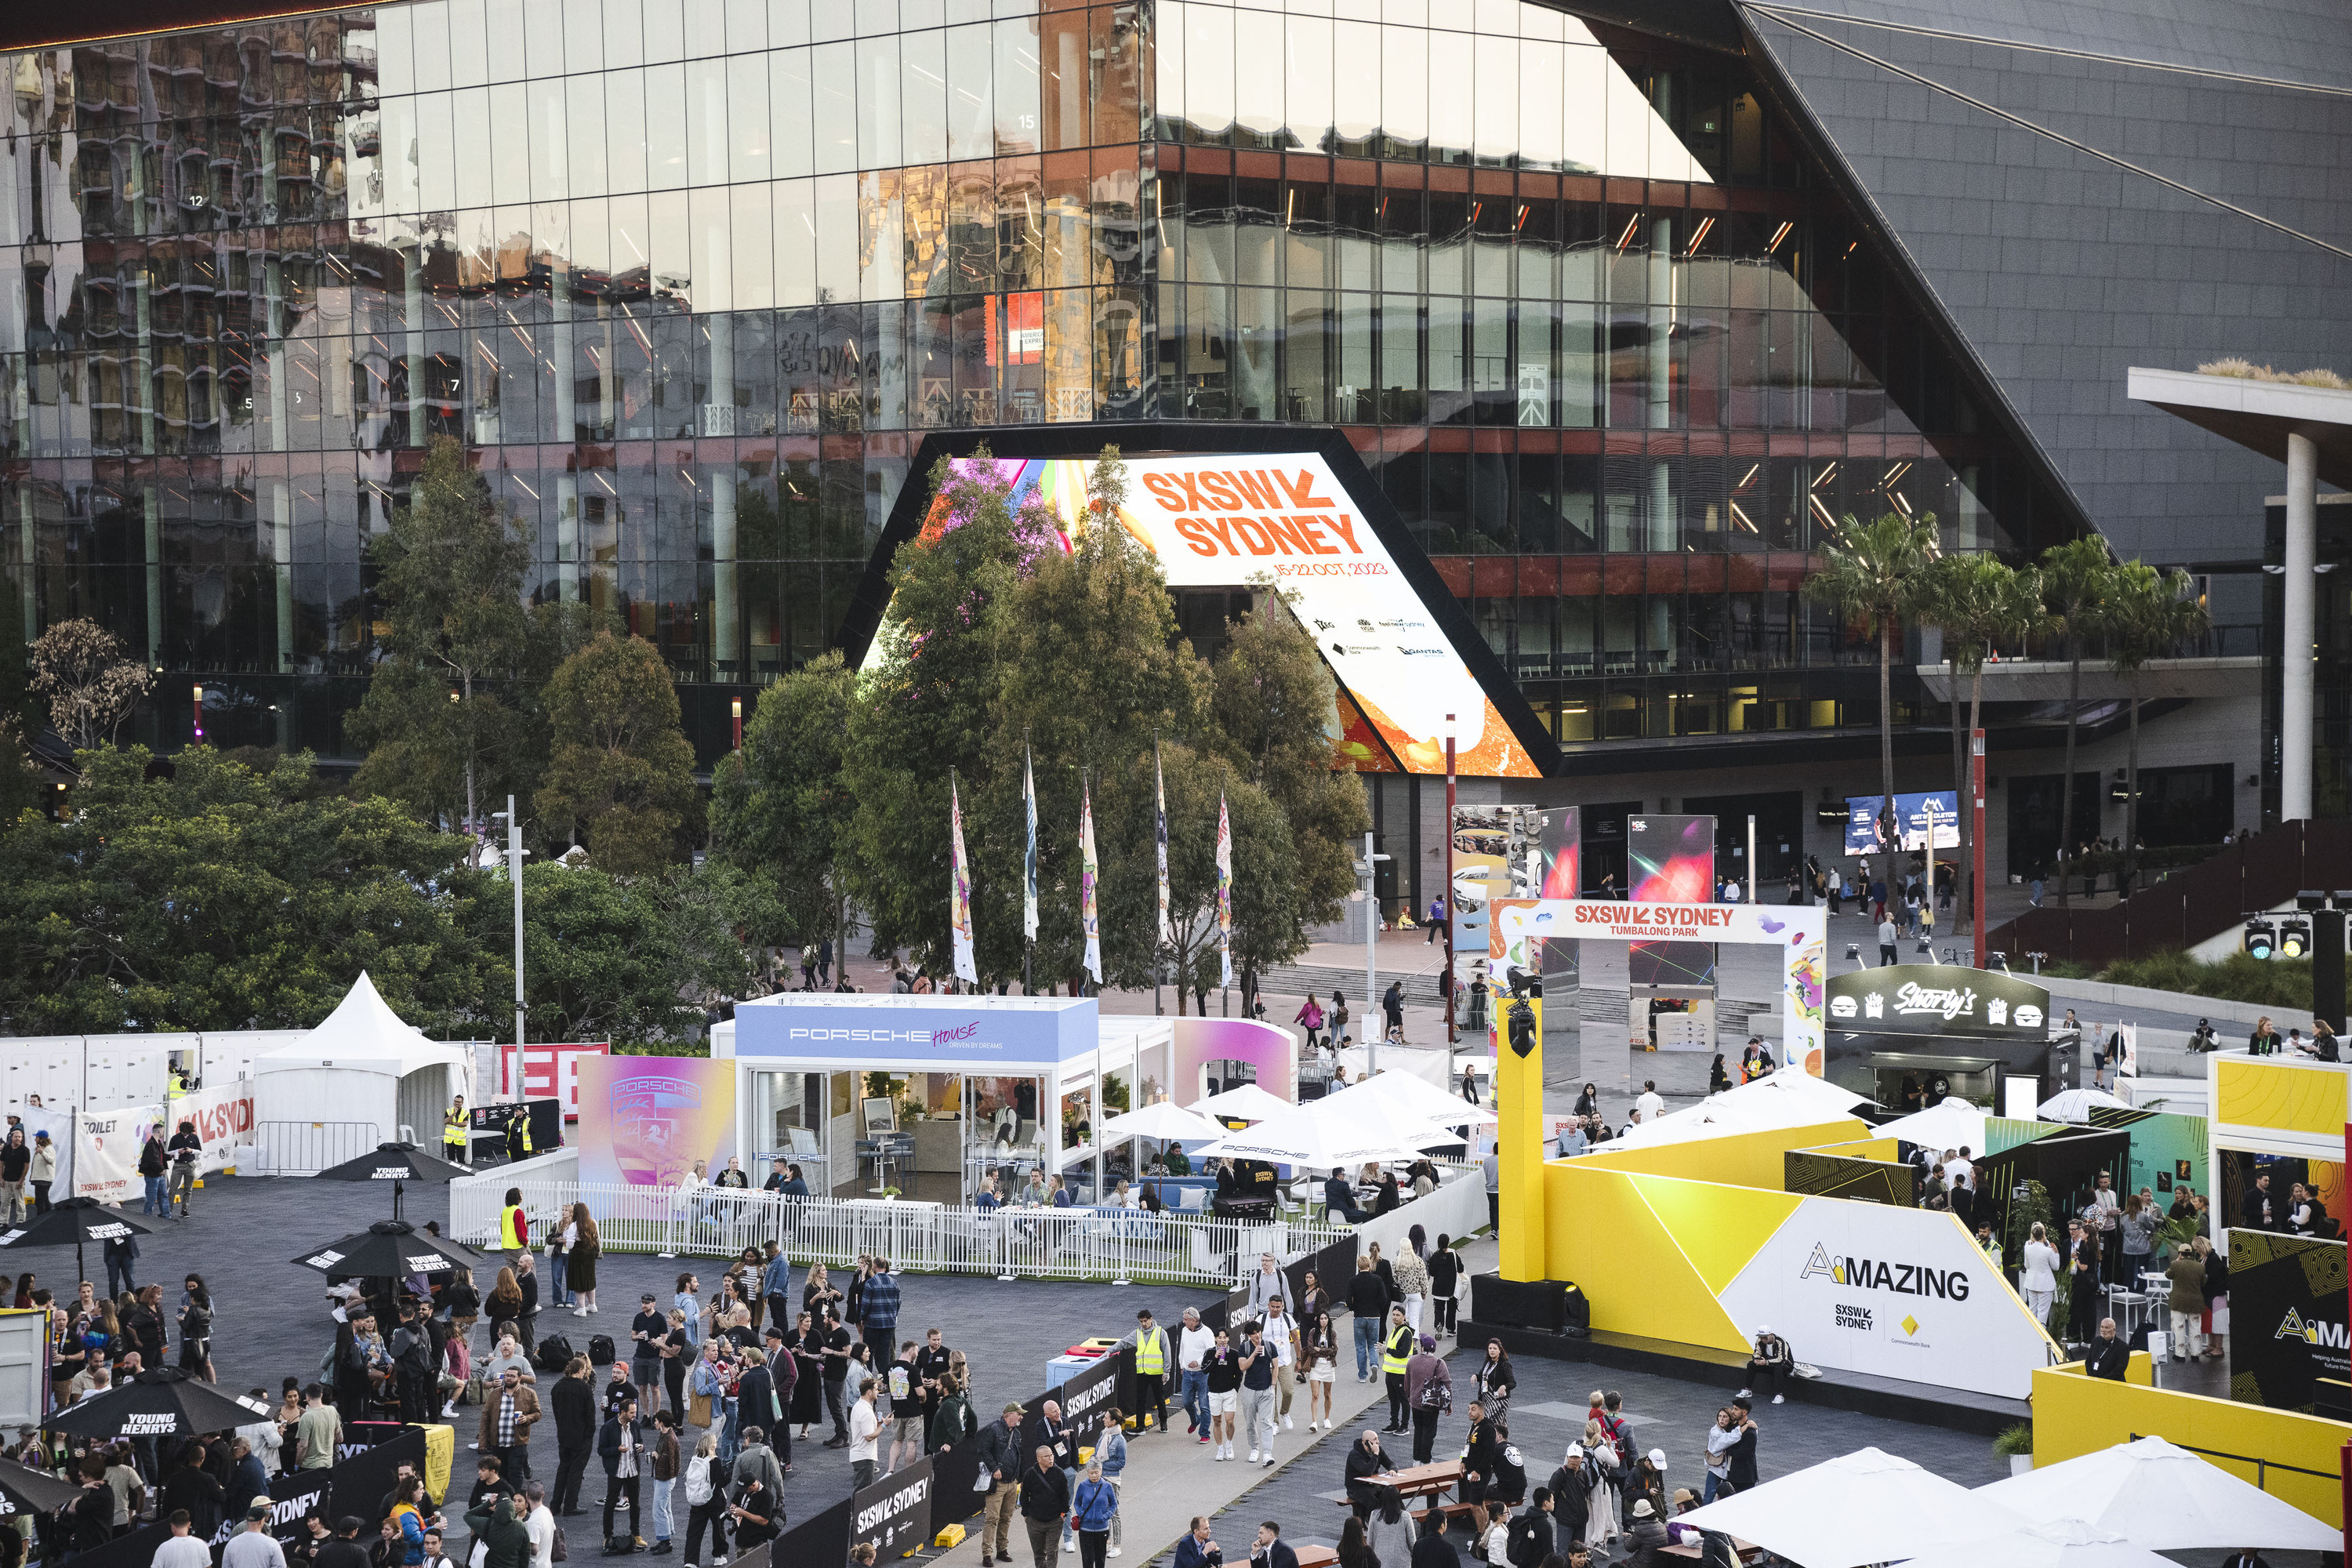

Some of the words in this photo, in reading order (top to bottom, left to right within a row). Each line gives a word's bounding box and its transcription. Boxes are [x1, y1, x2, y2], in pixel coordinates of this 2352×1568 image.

[1018, 114, 1035, 129] 15
[189, 196, 203, 207] 12
[451, 379, 459, 391] 7
[1142, 470, 1283, 512] SXSW
[1174, 514, 1363, 557] SYDNEY
[1274, 564, 1314, 576] 15-22
[1314, 564, 1352, 577] OCT,
[1348, 563, 1388, 575] 2023
[1575, 906, 1631, 924] SXSW
[1654, 907, 1734, 927] SYDNEY
[1610, 926, 1670, 936] TUMBALONG
[1893, 982, 1978, 1020] Shorty's
[790, 1028, 931, 1042] PORSCHE
[932, 1022, 980, 1047] HOUSE
[615, 1081, 698, 1098] PORSCHE
[84, 1120, 117, 1135] TOILET
[758, 1153, 828, 1162] PORSCHE
[1220, 1145, 1311, 1160] PORSCHE
[1332, 1148, 1403, 1161] PORSCHE
[966, 1159, 1037, 1167] PORSCHE
[80, 1182, 98, 1192] SXSW
[104, 1180, 128, 1190] SYDNEY
[86, 1221, 125, 1233] YOUNG
[89, 1227, 133, 1240] HENRYS
[405, 1254, 444, 1265] YOUNG
[408, 1260, 452, 1272] HENRYS
[1835, 1304, 1863, 1318] SXSW
[1835, 1316, 1873, 1331] SYDNEY
[1891, 1338, 1921, 1348] Commonwealth
[2312, 1353, 2331, 1363] Helping
[2331, 1356, 2351, 1365] Australia
[1067, 1390, 1087, 1418] SXSW
[1092, 1374, 1116, 1404] SYDNEY
[128, 1413, 176, 1425] YOUNG
[120, 1422, 177, 1435] HENRYS
[268, 1490, 321, 1526] YDNEY
[857, 1500, 884, 1534] SXSW
[894, 1476, 928, 1515] SYDNEY
